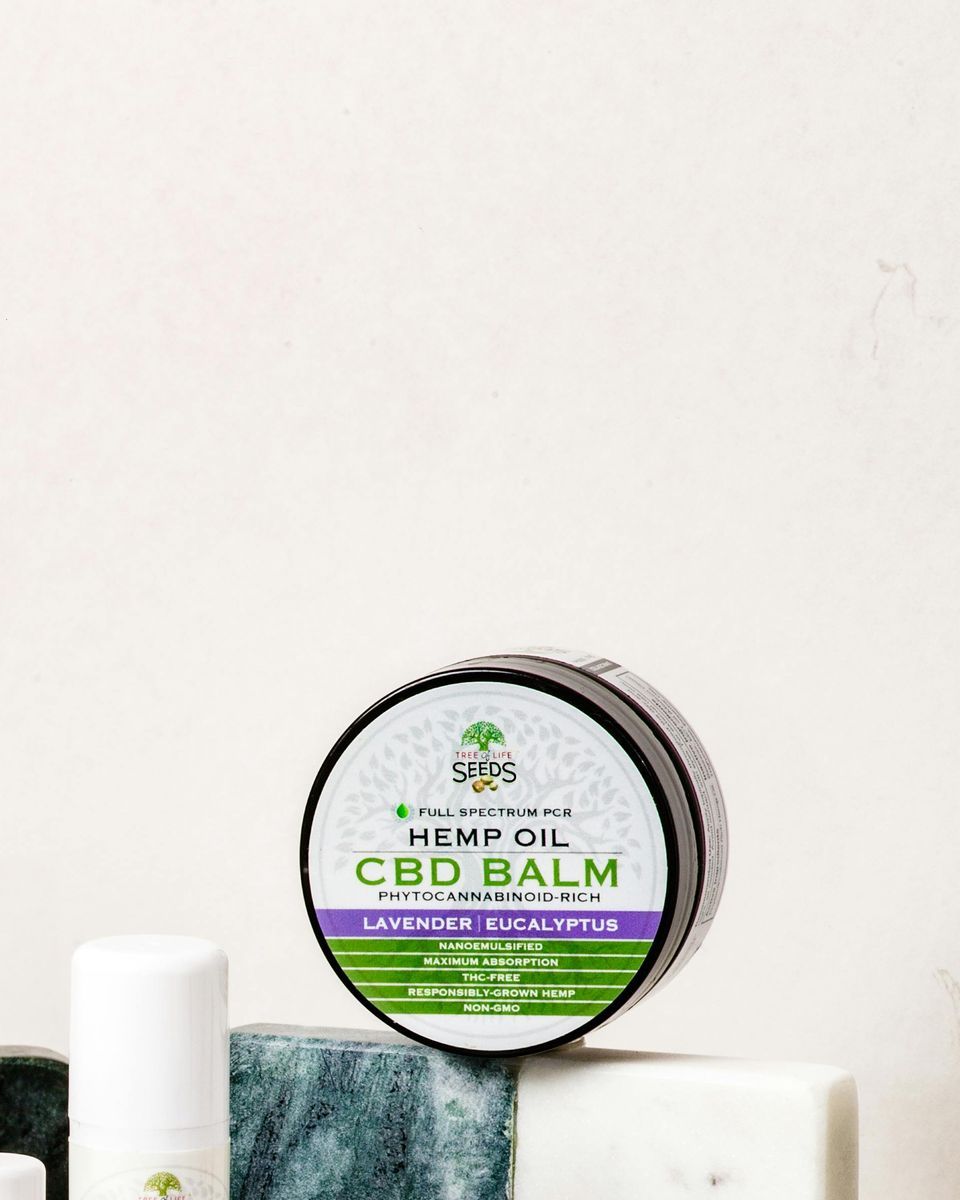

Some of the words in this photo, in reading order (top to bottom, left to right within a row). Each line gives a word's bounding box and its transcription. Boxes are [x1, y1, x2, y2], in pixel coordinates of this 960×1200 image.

[452, 762, 516, 782] SEEDS
[420, 808, 454, 816] FULL
[460, 808, 538, 817] SPECTRUM
[544, 808, 572, 817] PCR
[409, 828, 501, 847] HEMP
[515, 828, 569, 847] OIL
[356, 858, 460, 886] CBD
[483, 858, 618, 887] BALM
[379, 891, 600, 902] PHYTOCANNABINOID-RICH
[363, 917, 471, 931] LAVENDER
[486, 918, 618, 932] EUCALYPTUS
[439, 942, 543, 951] NANOEMULSIFIED
[424, 957, 478, 966] MAXIMUM
[482, 957, 559, 966] ABSORPTION
[462, 974, 520, 982] THC-FREE
[408, 989, 538, 998] RESPONSIBLY-GROWN
[542, 989, 575, 998] HEMP
[464, 1004, 520, 1012] NON-GMO
